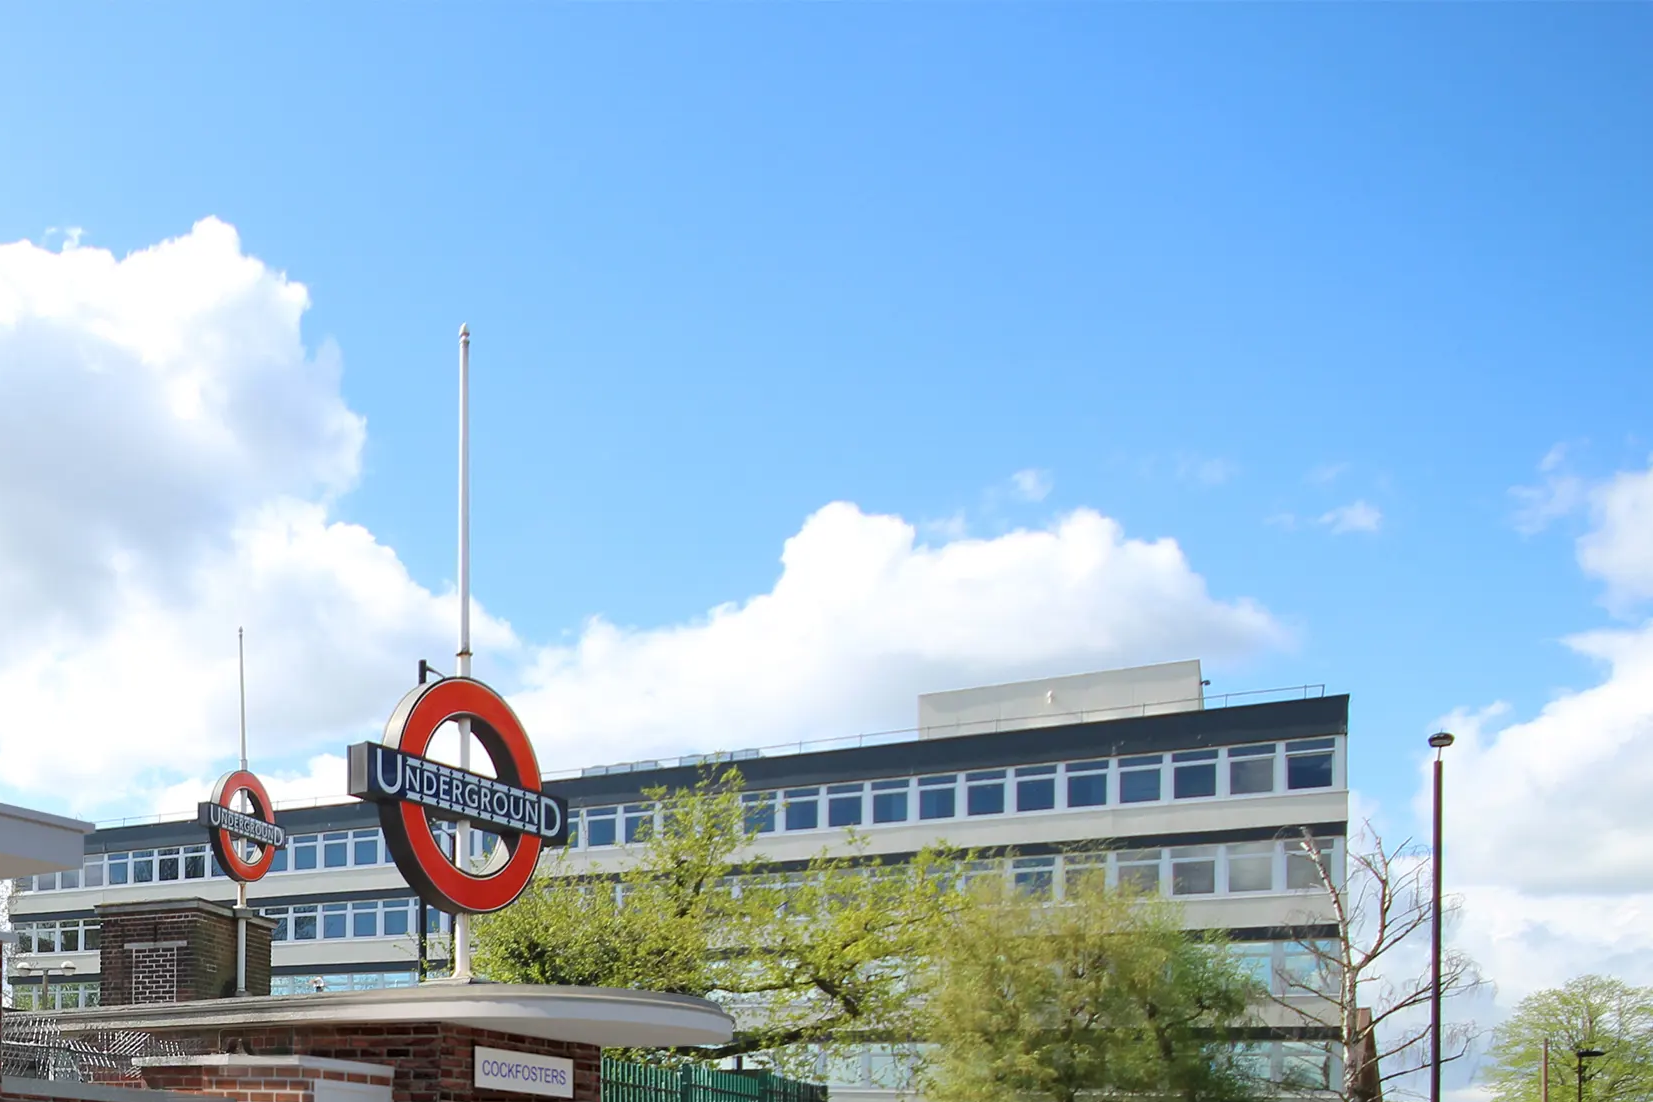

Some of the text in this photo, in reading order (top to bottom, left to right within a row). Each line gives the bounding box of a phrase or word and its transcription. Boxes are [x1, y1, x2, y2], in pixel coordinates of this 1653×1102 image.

[376, 747, 561, 837] UNDERGROUND
[210, 803, 283, 847] UNDERGROUND
[482, 1059, 567, 1086] COCKFOSTERS
